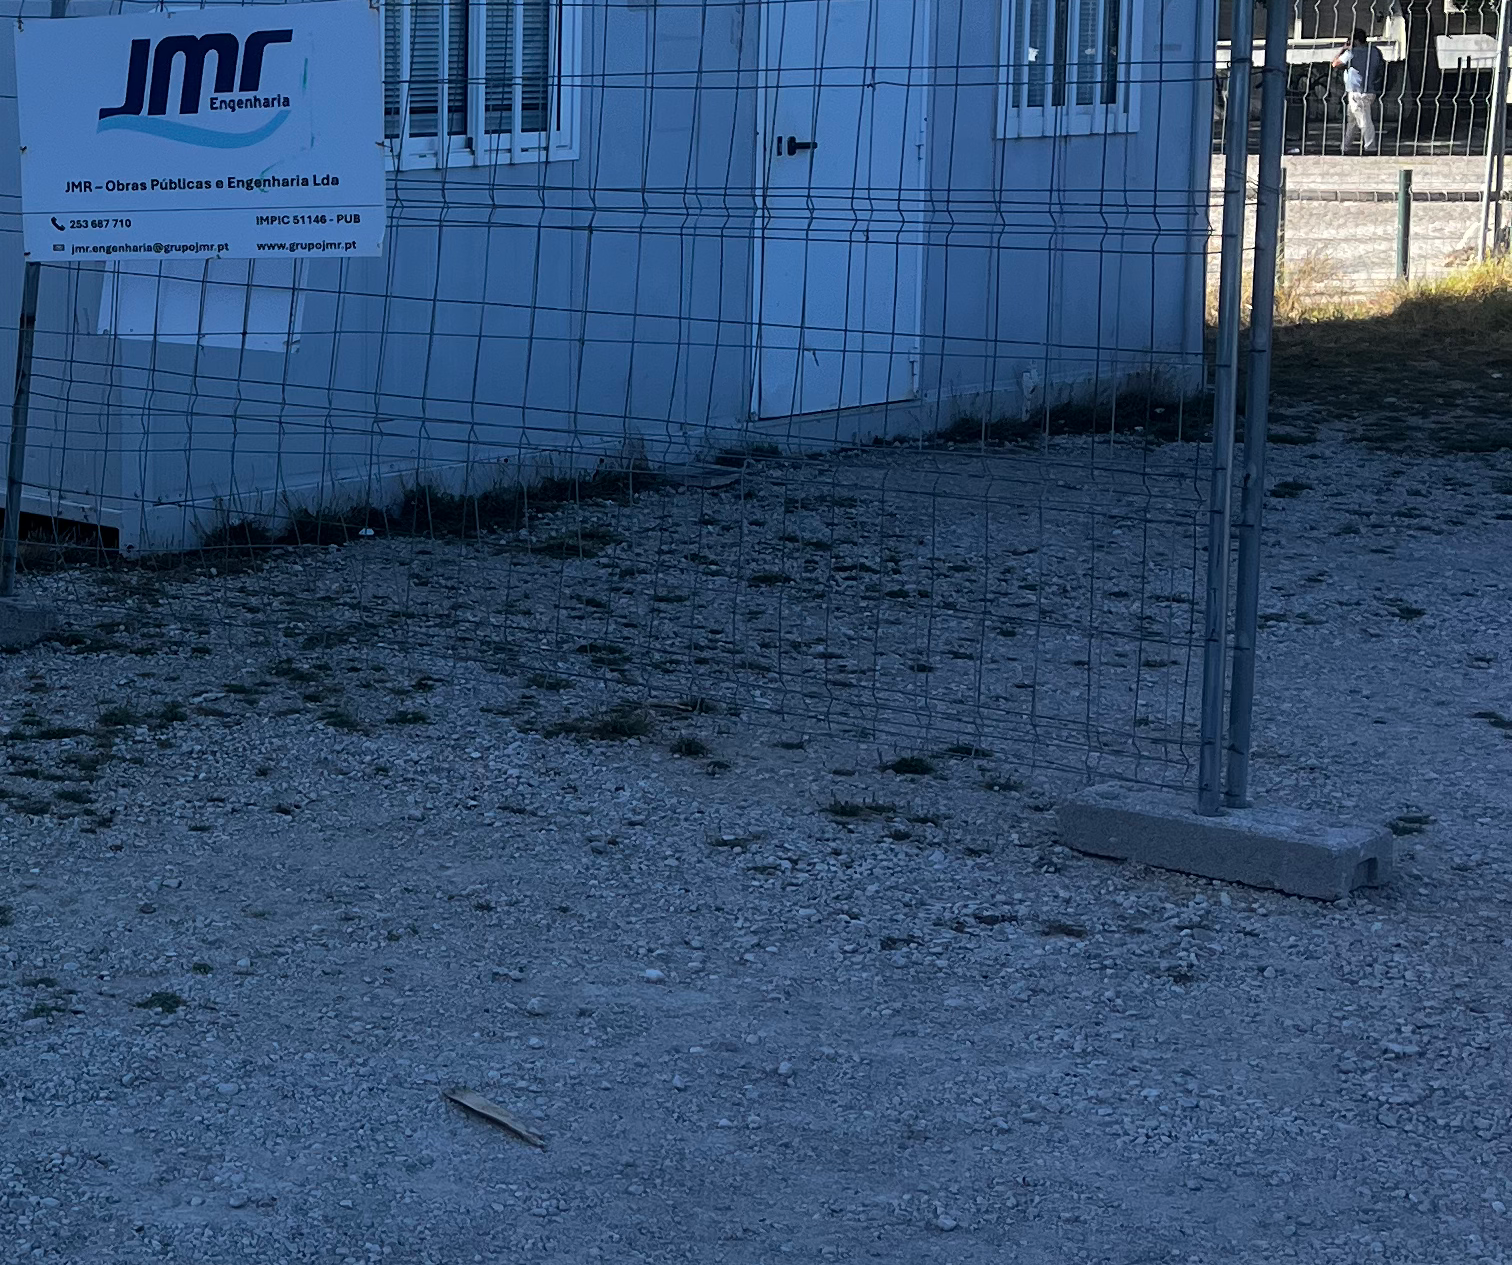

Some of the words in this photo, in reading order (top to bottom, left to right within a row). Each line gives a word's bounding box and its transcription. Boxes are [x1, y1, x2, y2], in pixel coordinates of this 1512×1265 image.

[210, 94, 290, 112] Engenharia
[65, 180, 92, 193] JMR
[105, 179, 147, 192] Obras
[151, 177, 212, 190] Públicas
[215, 179, 224, 189] e
[227, 175, 308, 192] Engenharia
[313, 174, 340, 187] Lda
[69, 219, 88, 229] 253
[90, 219, 110, 229] 687
[111, 218, 132, 228] 710
[256, 215, 290, 226] IMPIC
[292, 215, 326, 225] 51146
[337, 214, 361, 224] PUB
[71, 241, 229, 255] jmr.engenharia@grupojmr.pt
[256, 240, 357, 252] www.grupojmr.pt
